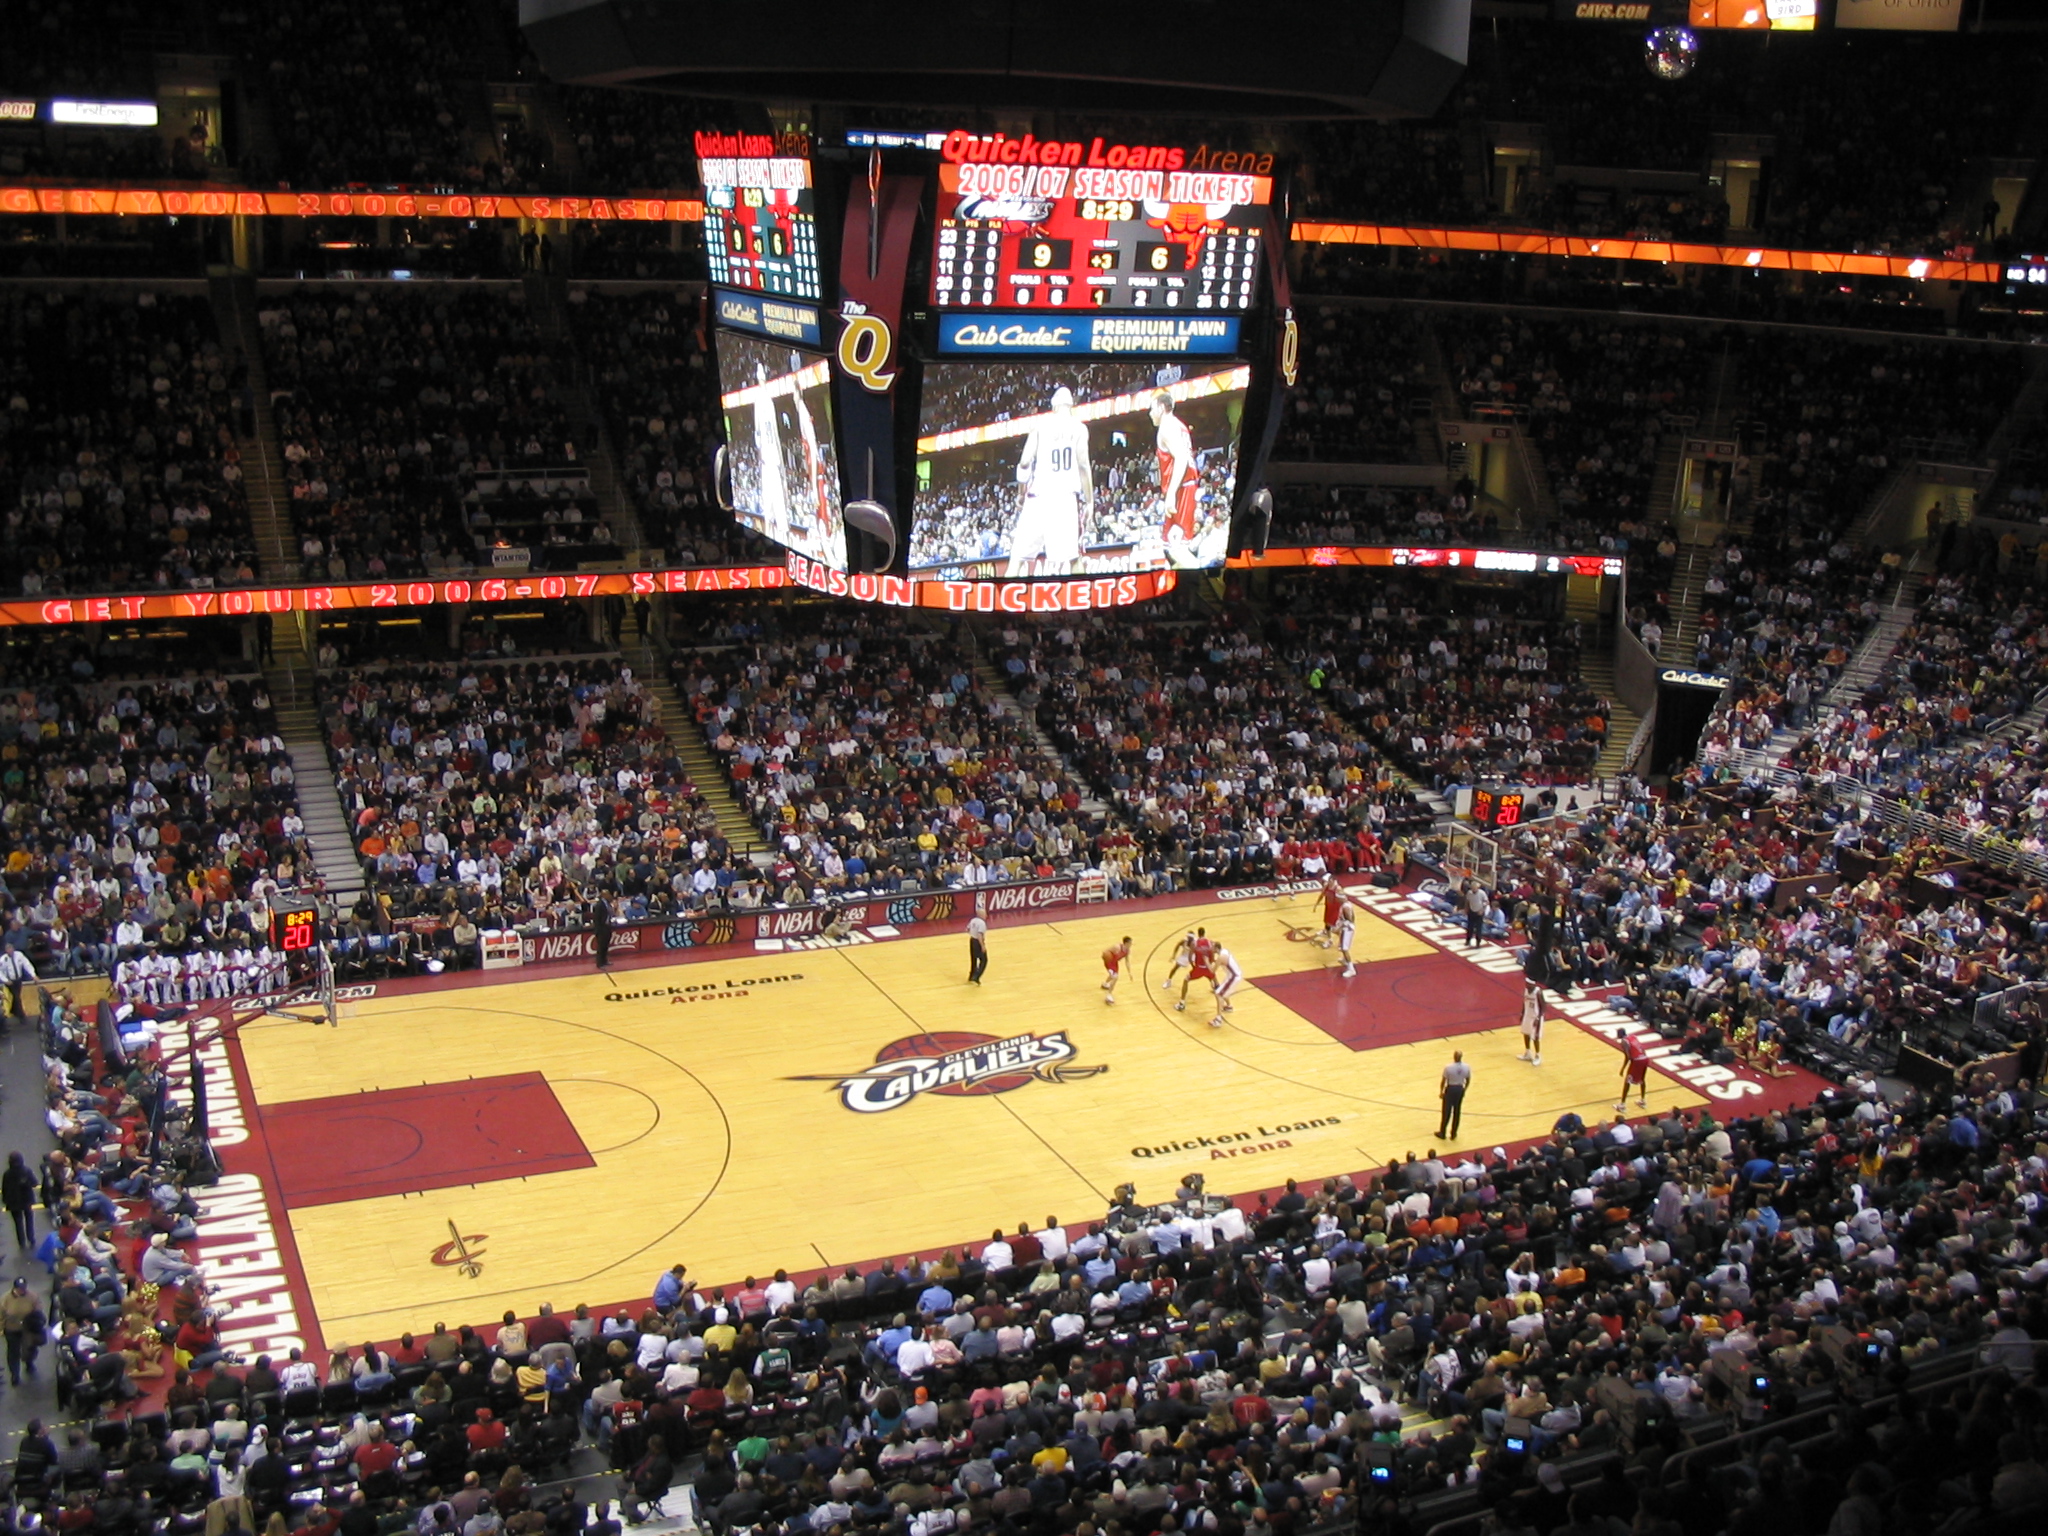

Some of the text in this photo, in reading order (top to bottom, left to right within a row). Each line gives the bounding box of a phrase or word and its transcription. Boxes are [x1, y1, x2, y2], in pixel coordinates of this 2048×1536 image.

[1576, 4, 1650, 18] CAVS.COM
[695, 131, 809, 157] Quicken Loans Arena
[942, 130, 1081, 166] Quicken
[1089, 138, 1184, 170] Loans
[1189, 144, 1275, 173] Arena
[958, 163, 1253, 205] 2006/07 SEASON TICKETS
[5, 190, 702, 221] GET YOUR 2006-07 SEASON
[1082, 200, 1134, 221] 8:29
[773, 233, 782, 256] 6
[966, 229, 976, 244] 2
[988, 230, 998, 245] 0
[1227, 237, 1236, 251] 2
[1246, 237, 1255, 251] 0
[965, 245, 974, 259] 7
[986, 246, 996, 260] 0
[1033, 244, 1052, 268] 9
[1091, 253, 1112, 270] +3
[1151, 247, 1168, 270] 6
[1206, 251, 1215, 265] 3
[939, 260, 995, 275] 11 0 0
[1201, 266, 1216, 280] 12
[936, 275, 993, 291] 20 0 0
[1203, 281, 1212, 294] 7
[1221, 281, 1230, 294] 4
[843, 301, 866, 314] The
[938, 291, 992, 305] 2 0 0
[1094, 289, 1104, 306] 1
[1134, 290, 1146, 307] 2
[953, 325, 1071, 347] Cub Cadet
[1092, 319, 1226, 337] PREMIUM LAWN
[839, 313, 895, 390] Q
[1091, 334, 1190, 353] EQUIPMENT
[1052, 447, 1072, 472] 90
[1448, 551, 1460, 566] 3
[1546, 557, 1560, 572] 2
[786, 550, 1138, 612] SEASON TICKETS
[42, 566, 785, 623] GET YOUR 2006-07 SEASO
[1662, 670, 1729, 689] Cub Cadet
[1501, 795, 1521, 806] 8:29
[1497, 806, 1518, 824] 20
[989, 883, 1076, 911] NBA Cares
[287, 911, 313, 926] 8:29
[773, 909, 814, 935] NBA
[284, 924, 310, 950] 20
[539, 934, 583, 960] NBA
[604, 972, 804, 1002] Quicken Loans
[670, 989, 750, 1005] Arena
[944, 1034, 1030, 1064] CLEVELAND
[841, 1034, 1073, 1112] CAVALIERS
[1130, 1114, 1342, 1158] Quicken Loans
[1210, 1139, 1293, 1160] Arena
